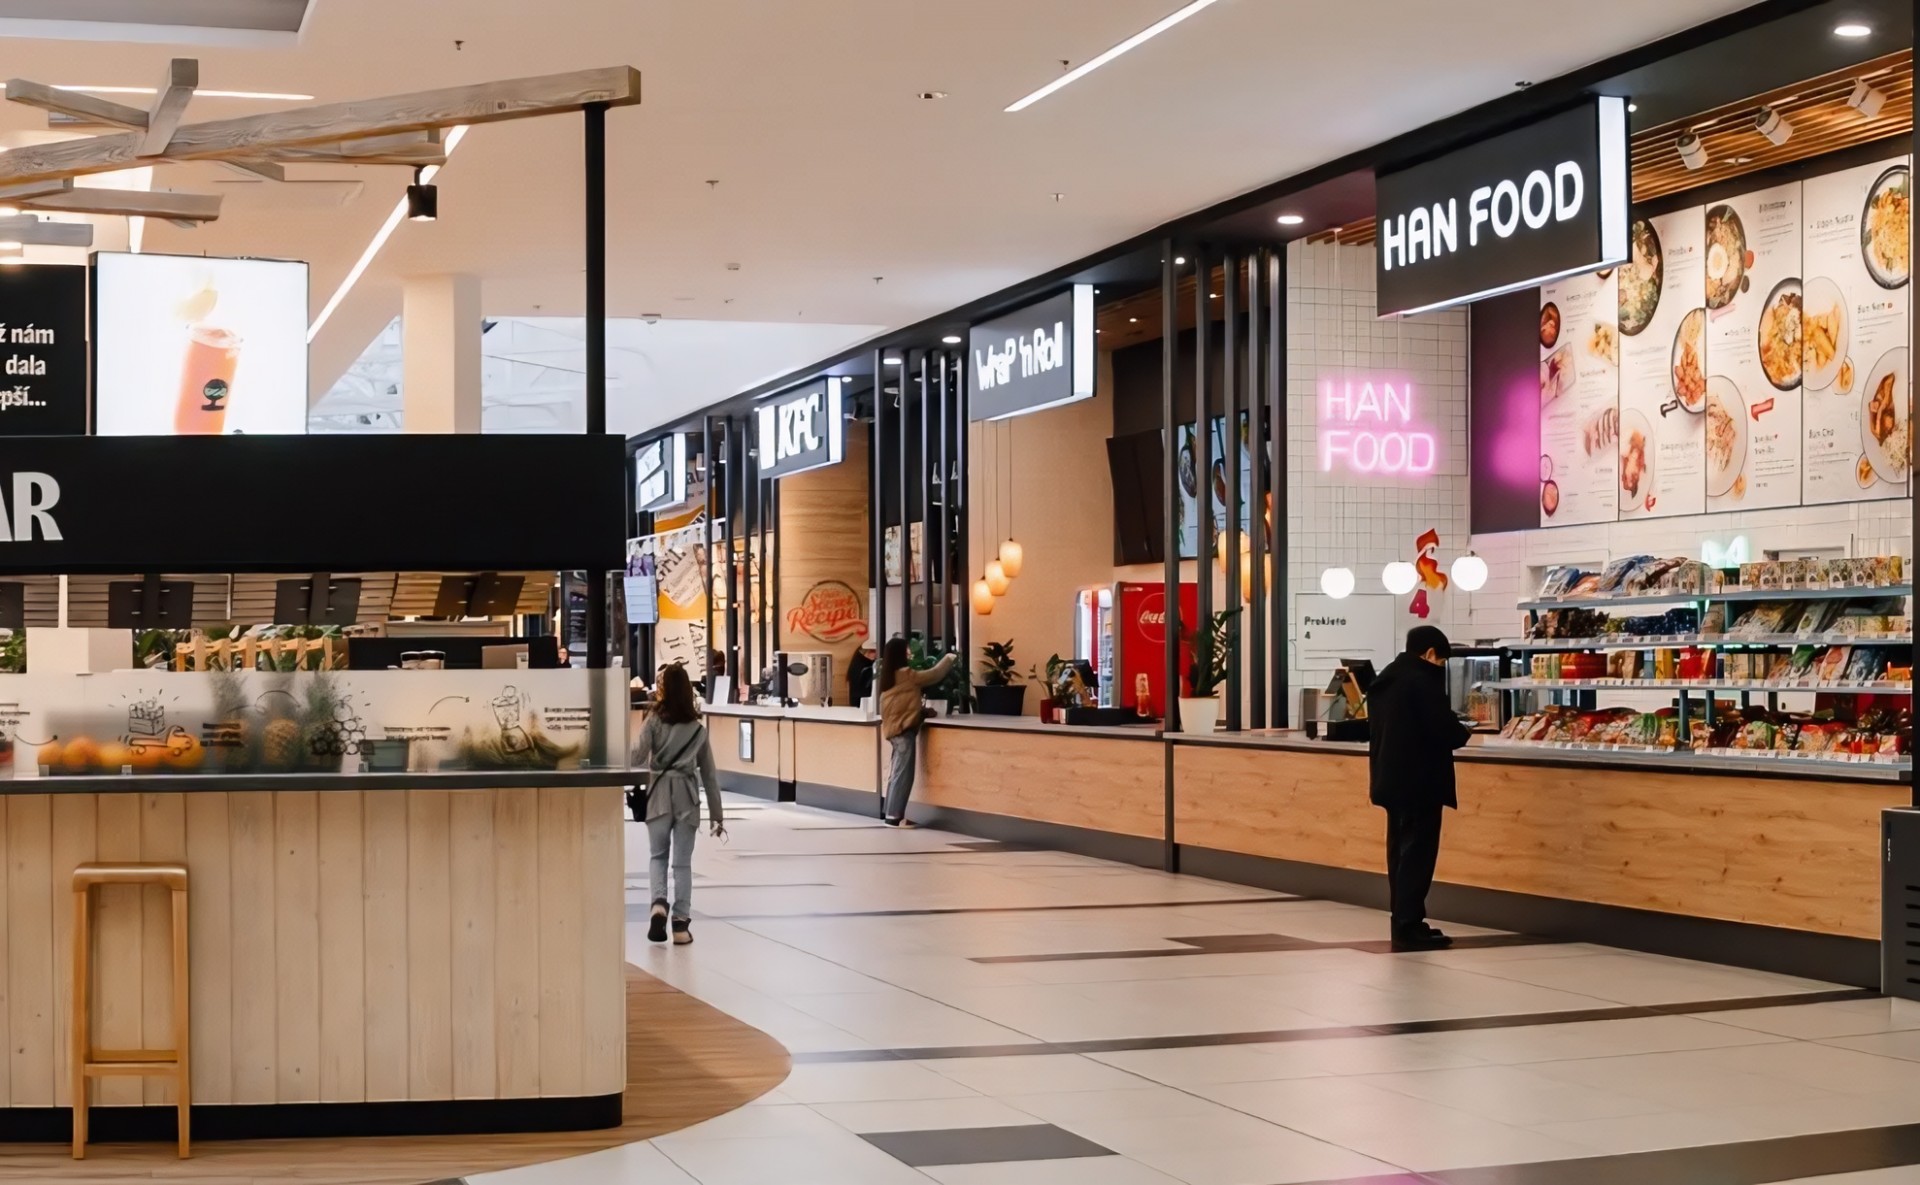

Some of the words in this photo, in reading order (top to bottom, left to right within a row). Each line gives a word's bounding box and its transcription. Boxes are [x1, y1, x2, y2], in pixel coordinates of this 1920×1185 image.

[1384, 197, 1458, 271] HAN
[1469, 160, 1584, 247] FOOD
[11, 323, 54, 344] nám
[6, 354, 46, 375] dala
[0, 385, 46, 410] pší...
[1325, 381, 1411, 423] HAN
[777, 393, 822, 459] KFC
[1323, 430, 1435, 472] FOOD
